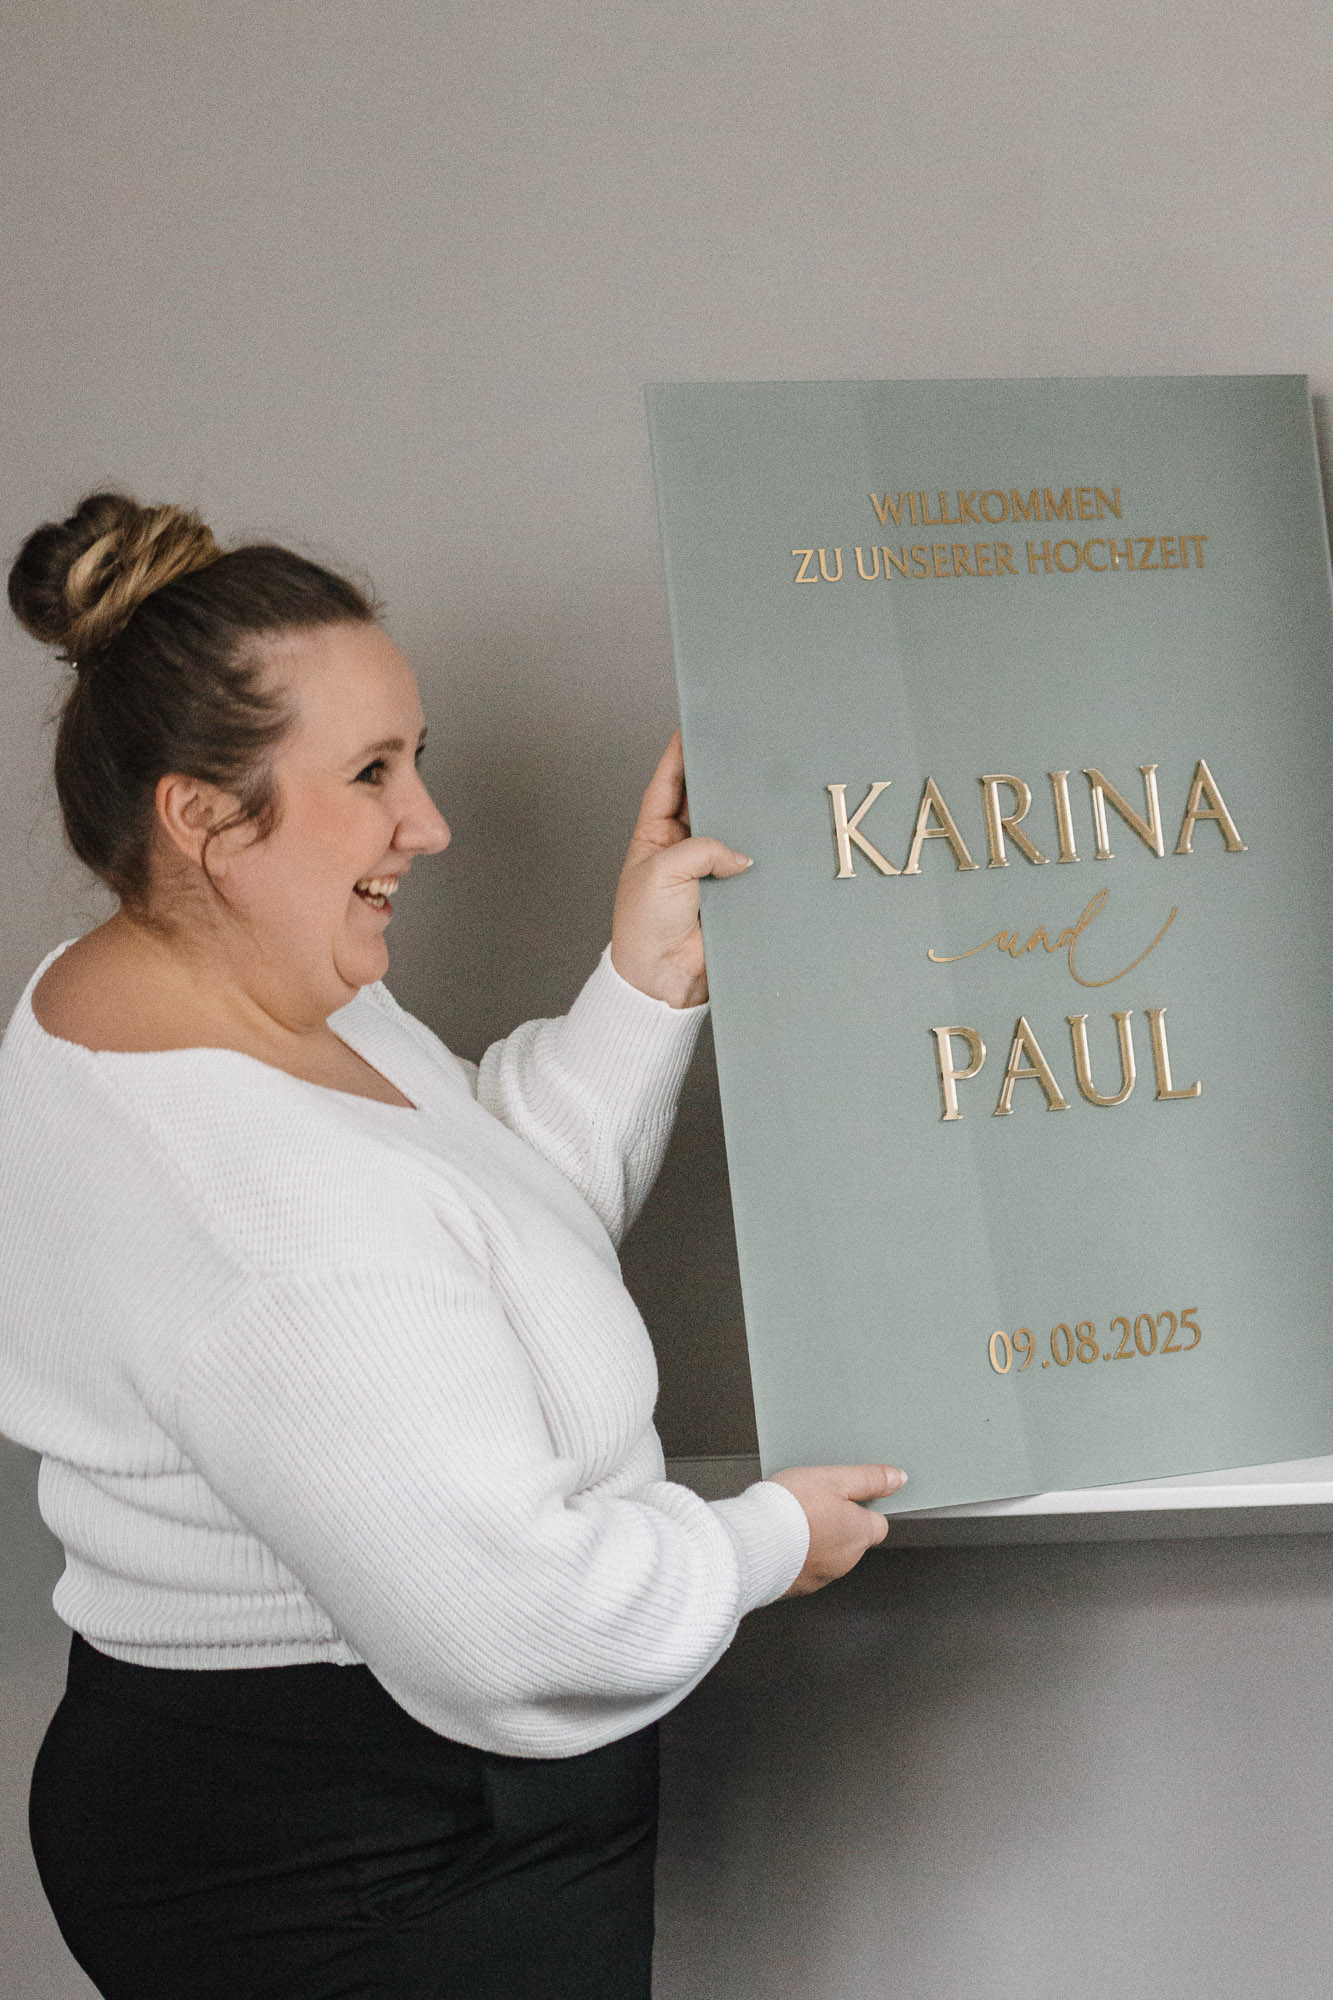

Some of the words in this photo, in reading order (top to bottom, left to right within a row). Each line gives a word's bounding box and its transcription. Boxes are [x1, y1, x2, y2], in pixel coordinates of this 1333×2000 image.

[870, 487, 1123, 527] WILLKOMMEN
[791, 548, 843, 583] ZU
[854, 541, 1018, 581] UNSERER
[1026, 535, 1208, 575] HOCHZEIT
[827, 759, 1249, 879] KARINA
[928, 889, 1177, 987] und
[930, 1007, 1202, 1121] PAUL
[988, 1307, 1201, 1374] 09.08.2025
